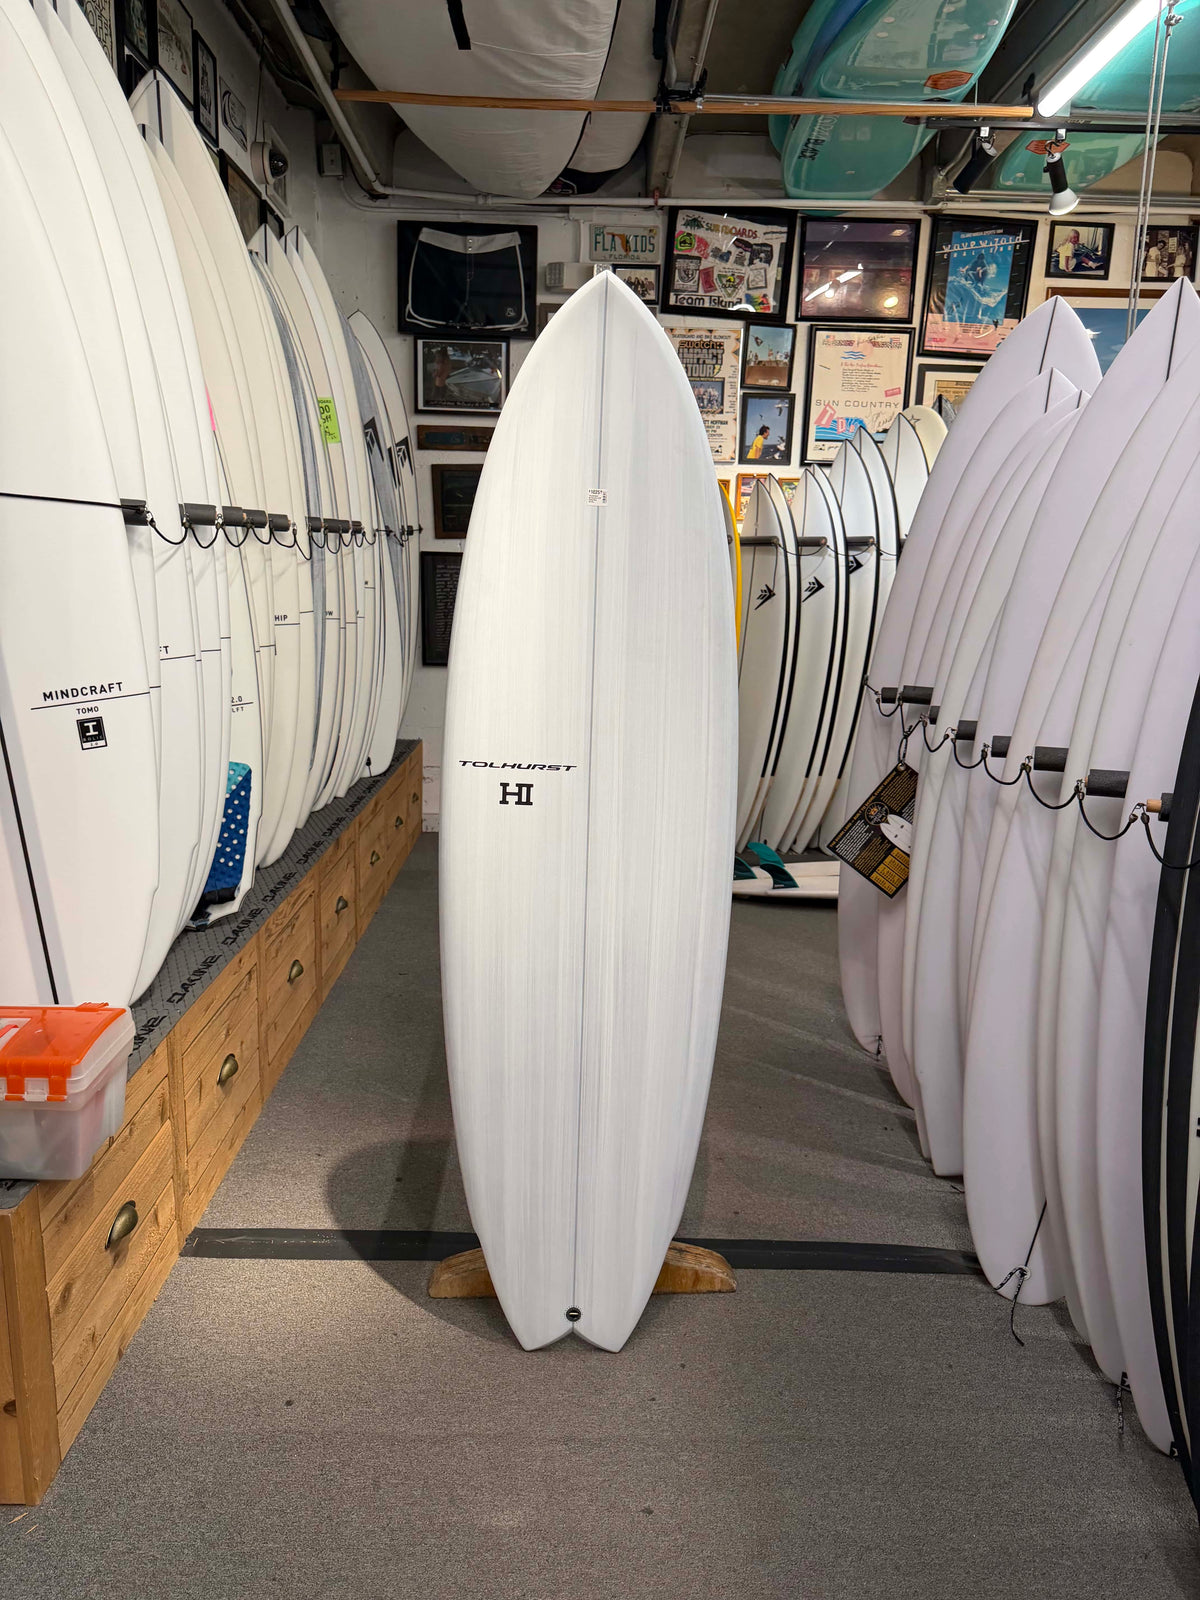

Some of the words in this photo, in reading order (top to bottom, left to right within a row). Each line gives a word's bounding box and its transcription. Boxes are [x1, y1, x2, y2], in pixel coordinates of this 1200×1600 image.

[594, 233, 616, 252] FLA
[625, 234, 655, 253] KIDS
[942, 240, 976, 252] wave
[674, 293, 705, 305] Team
[709, 295, 742, 309] Island
[679, 340, 716, 349] swatch
[679, 348, 724, 365] IMPACT
[686, 364, 714, 377] TOUR
[815, 399, 840, 407] SUN
[844, 400, 900, 409] COUNTRY
[42, 681, 123, 702] MINDCRAFT
[76, 705, 99, 715] TOMO
[458, 759, 577, 772] TOLHURST
[296, 839, 325, 865] DAKINE
[262, 871, 297, 903] DAKINE
[221, 907, 265, 946] DAKINE
[166, 953, 222, 1005] DAKINE
